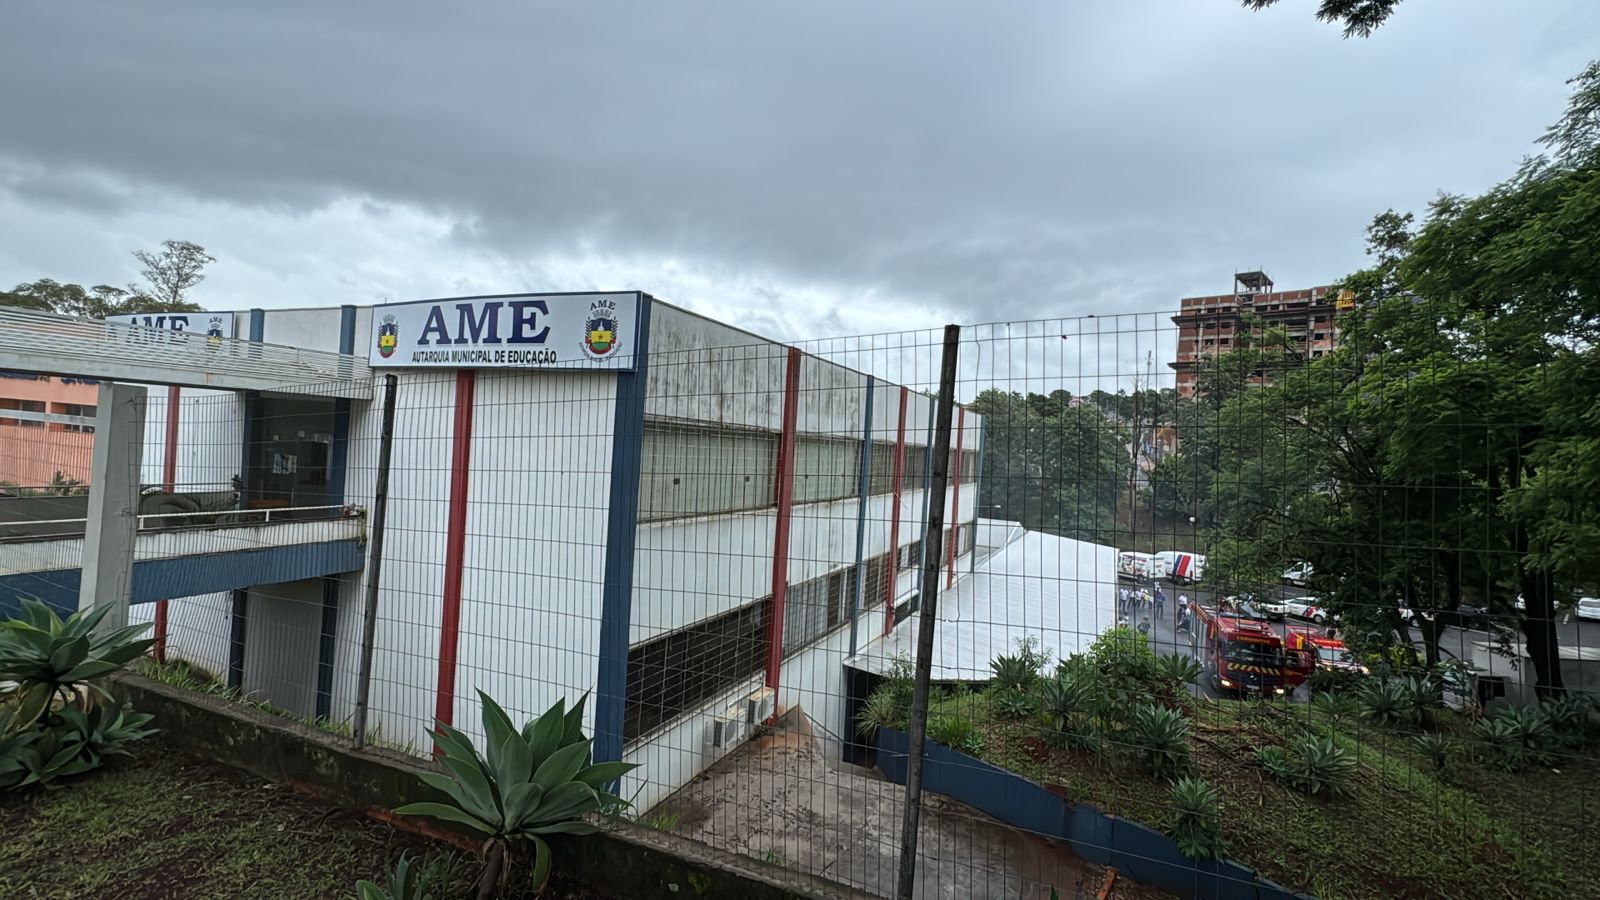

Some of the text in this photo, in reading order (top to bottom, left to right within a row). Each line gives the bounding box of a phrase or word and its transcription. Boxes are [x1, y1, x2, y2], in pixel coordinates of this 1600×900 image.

[590, 300, 616, 311] AME
[417, 300, 551, 345] AME
[412, 347, 557, 364] AUTARQUIA MUNICIPAL DE EDUCAÇÃO
